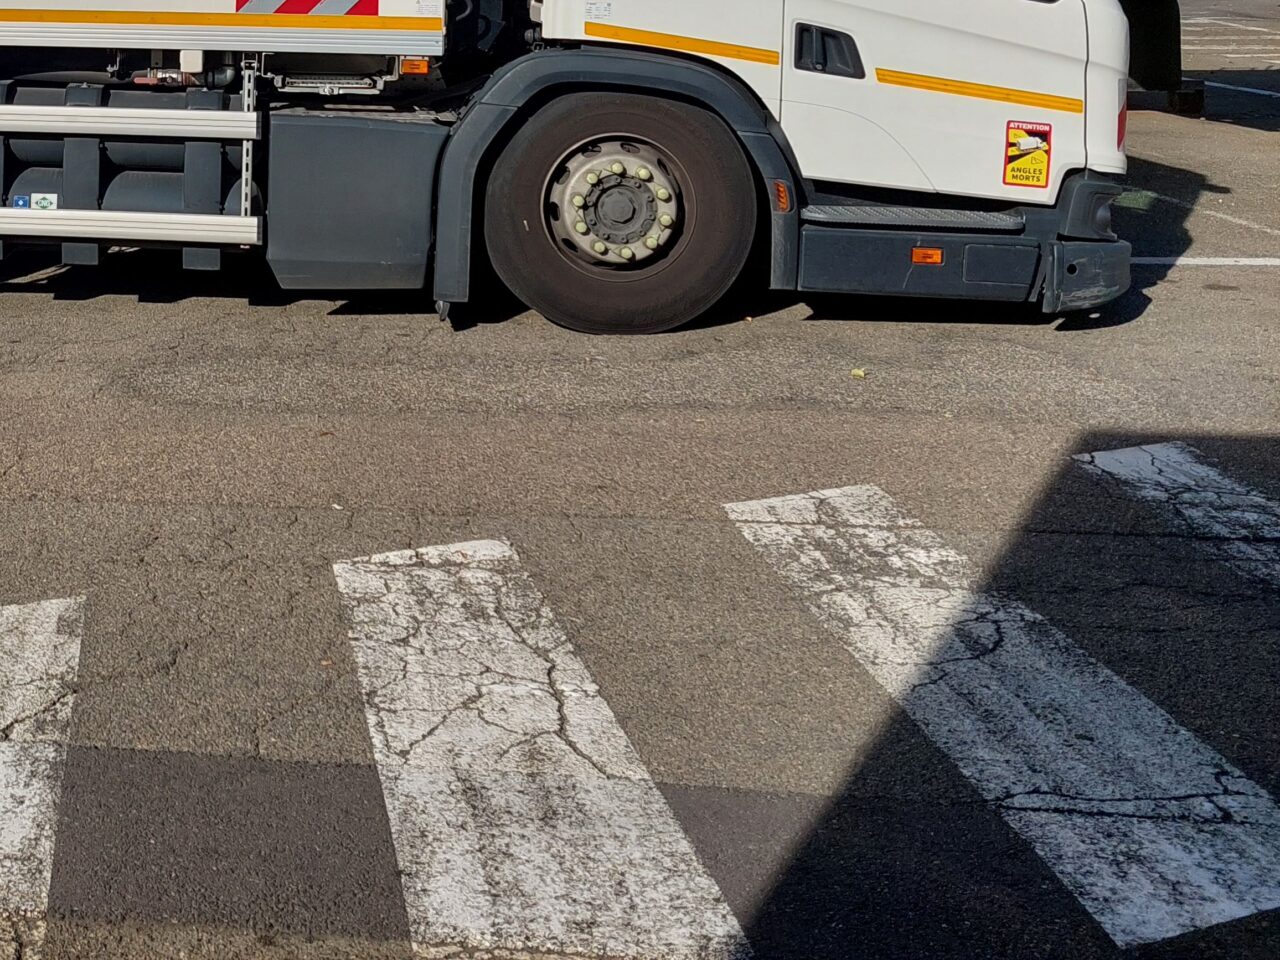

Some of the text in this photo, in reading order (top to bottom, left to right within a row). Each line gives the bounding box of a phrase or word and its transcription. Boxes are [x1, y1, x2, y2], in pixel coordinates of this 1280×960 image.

[1009, 122, 1050, 131] ATTENTION
[1010, 166, 1043, 176] ANGLES
[1011, 174, 1041, 183] MORTS
